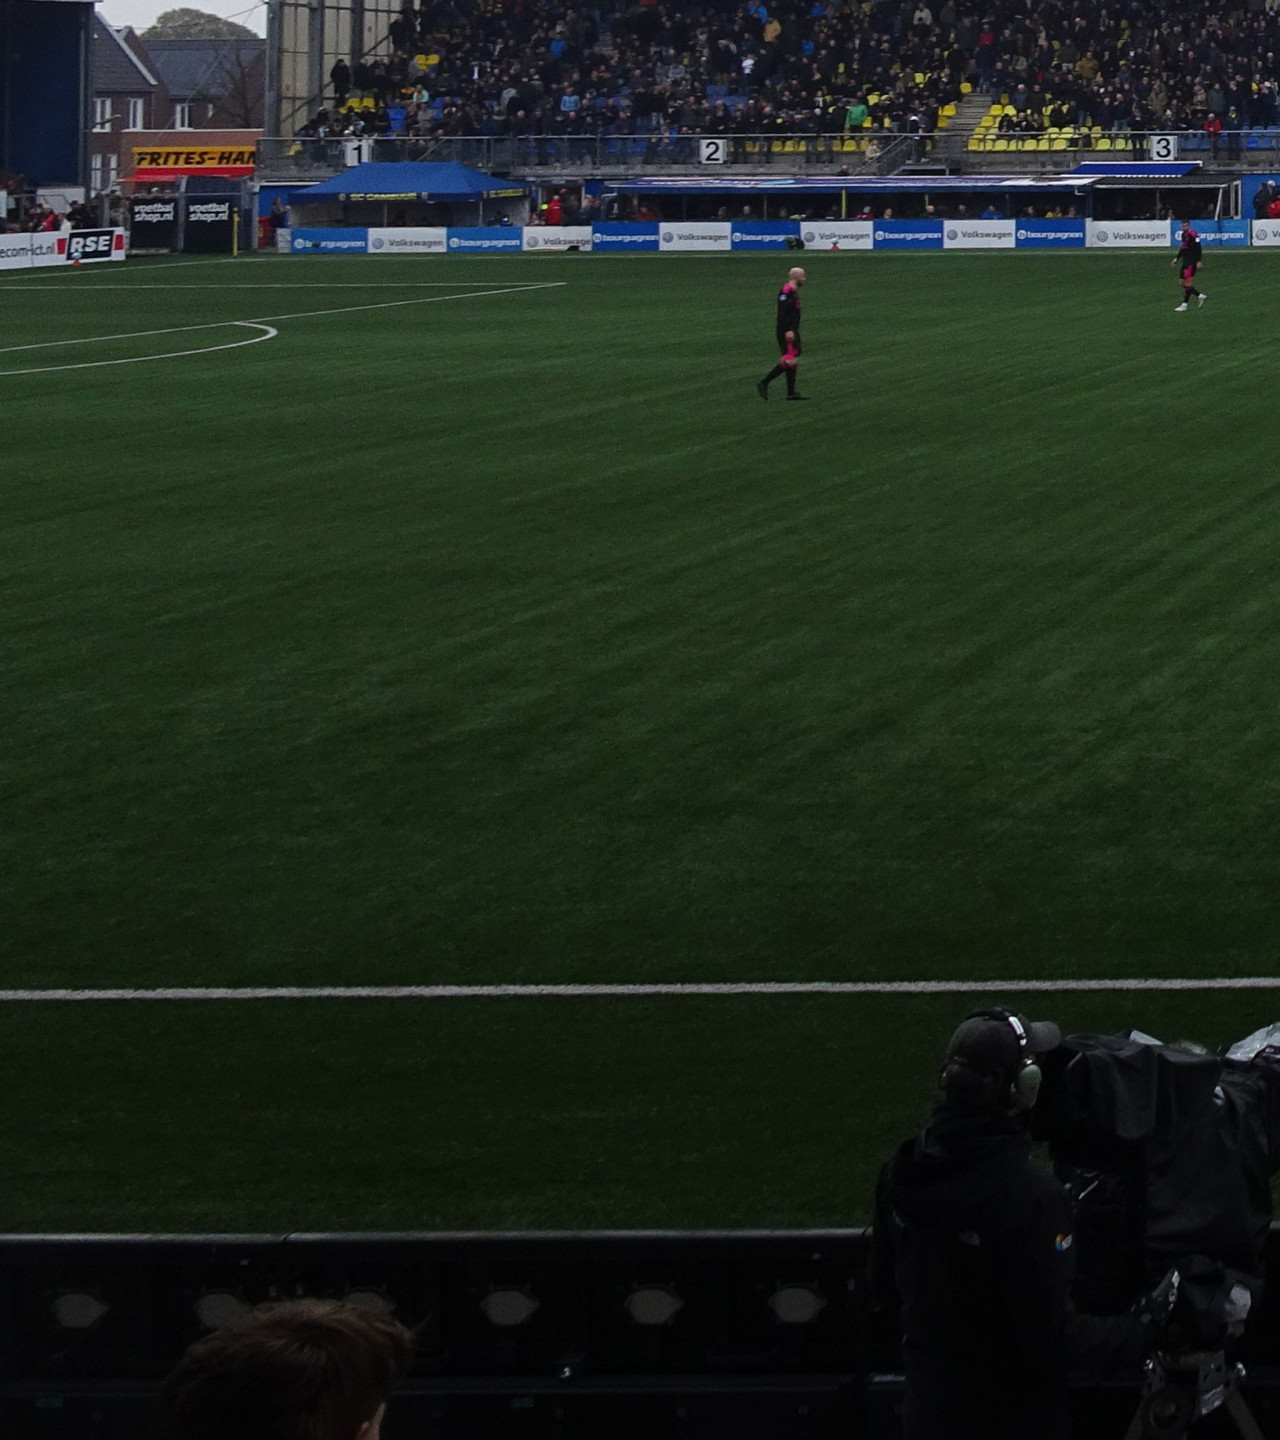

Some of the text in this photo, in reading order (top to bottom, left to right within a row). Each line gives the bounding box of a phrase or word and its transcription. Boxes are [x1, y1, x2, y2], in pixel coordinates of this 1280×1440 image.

[352, 144, 362, 163] 1
[705, 141, 721, 161] 2
[1155, 138, 1171, 158] 3
[134, 202, 175, 213] voetbal
[189, 202, 229, 213] voetbal
[134, 212, 174, 223] shop.nl
[189, 212, 229, 223] shop.nl
[677, 233, 728, 243] Volkswagen
[818, 232, 870, 242] Volkswagen
[885, 231, 942, 241] bourguignon
[961, 230, 1013, 240] Volkswagen
[1027, 231, 1083, 240] bourguignon
[1112, 231, 1167, 242] Volkswagen
[69, 235, 111, 253] RSE
[388, 238, 444, 249] Volkswagen
[543, 237, 590, 247] Volkswage
